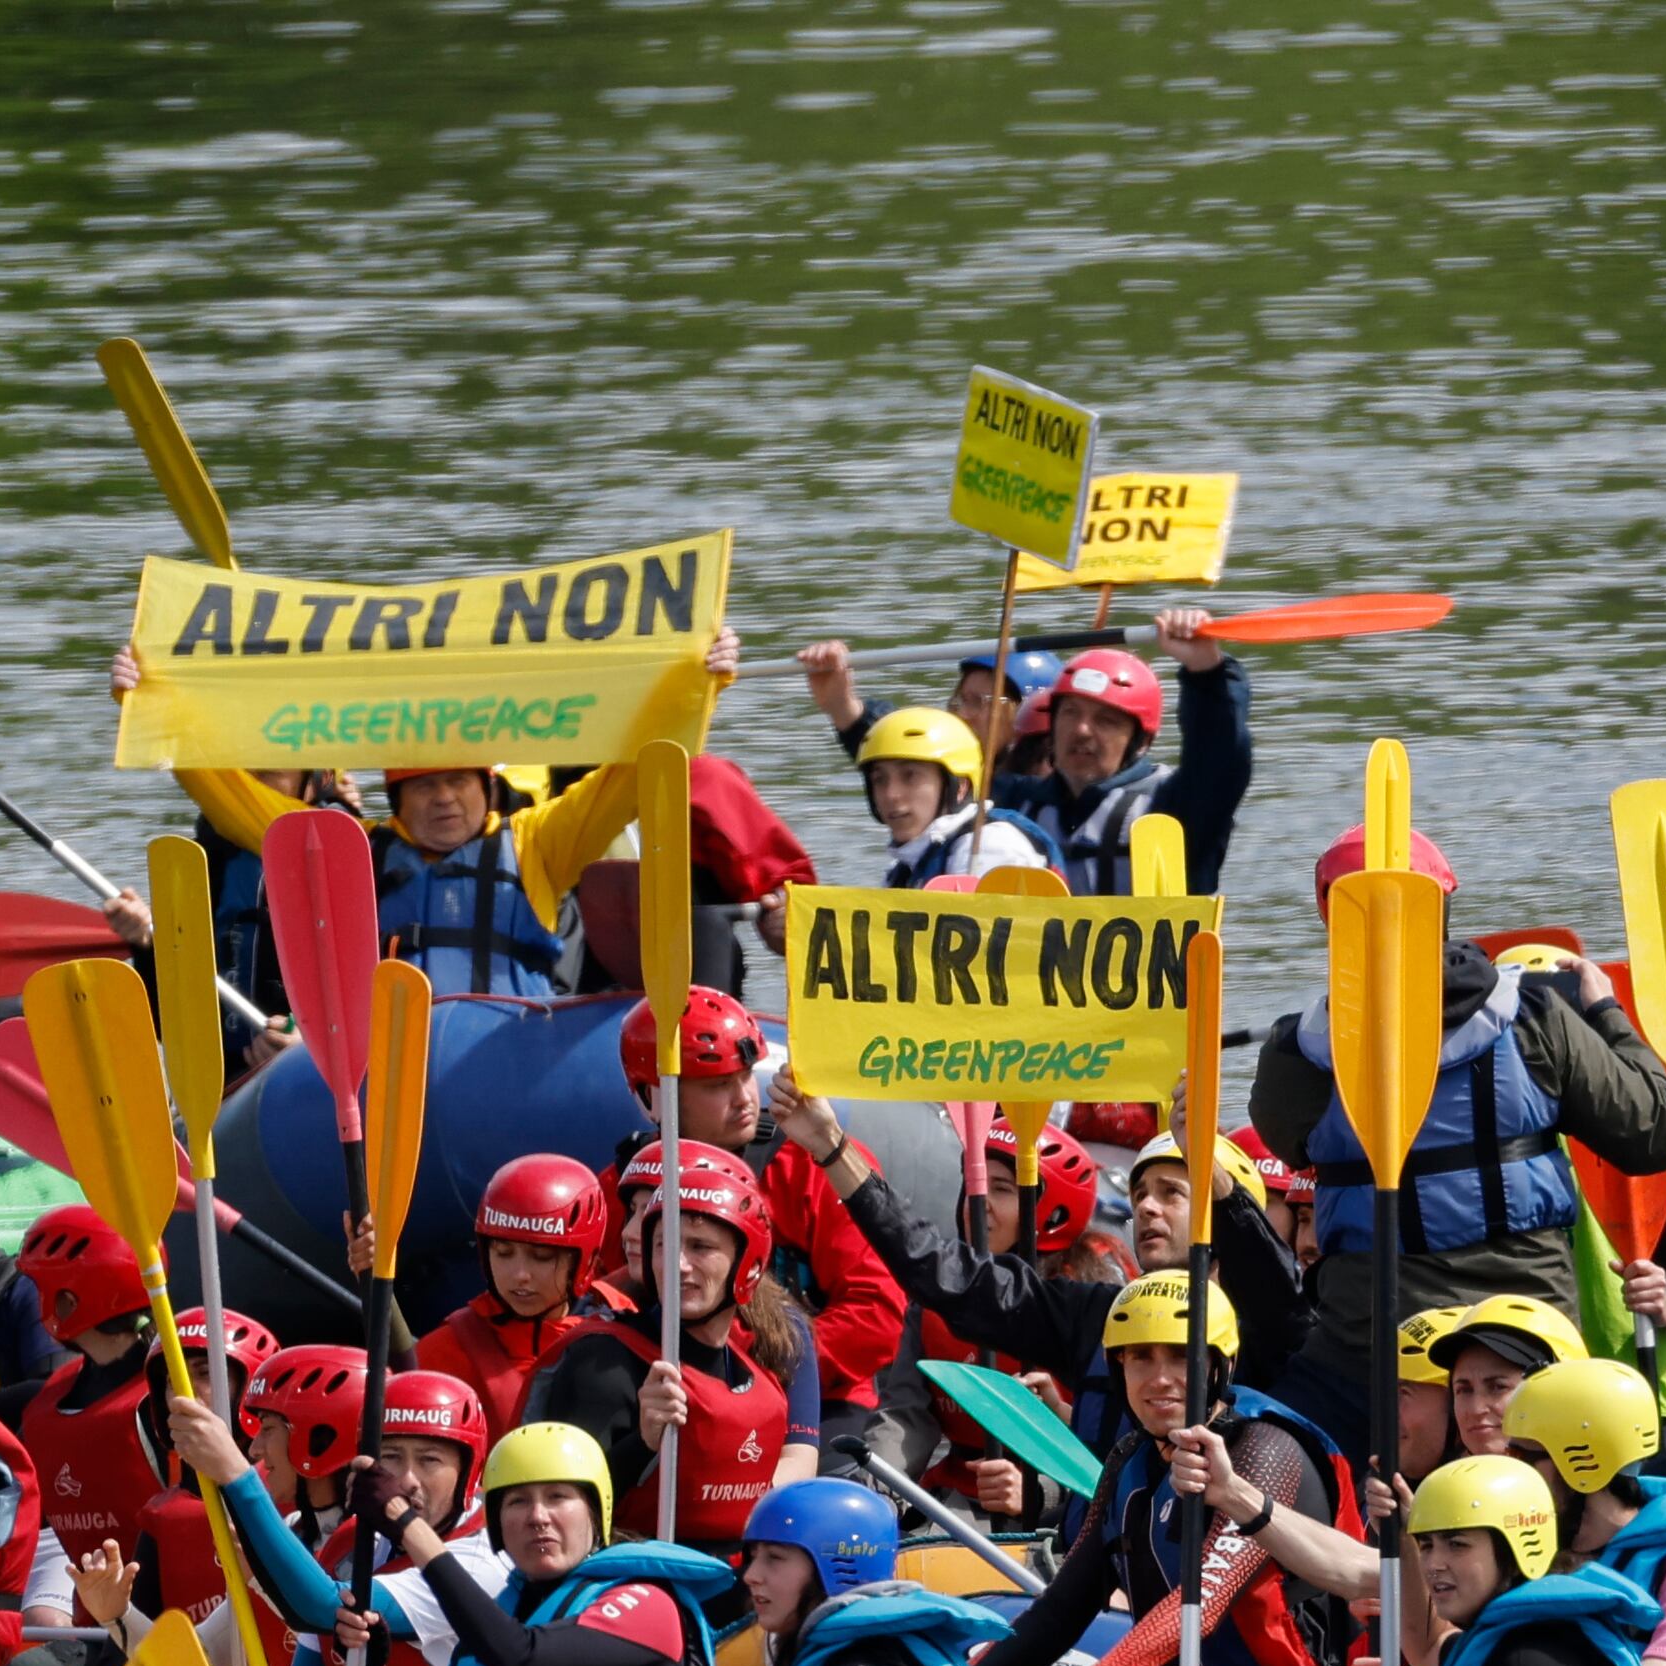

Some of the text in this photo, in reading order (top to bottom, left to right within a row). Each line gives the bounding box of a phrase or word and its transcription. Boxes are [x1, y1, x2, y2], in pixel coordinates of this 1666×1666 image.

[973, 387, 1081, 461] ALTRI NON
[960, 453, 1072, 525] GREENPEACE
[1089, 484, 1189, 513] LTRI
[171, 551, 697, 657] ALTRI NON
[261, 693, 598, 748] GREENPEACE
[804, 908, 1201, 1011] ALTRI NON
[858, 1035, 1126, 1085] GREENPEACE
[484, 1206, 565, 1237] TURNAUGA
[653, 1188, 723, 1205] TNAUG
[383, 1407, 453, 1427] URNAUG
[701, 1482, 771, 1502] TURNAUG
